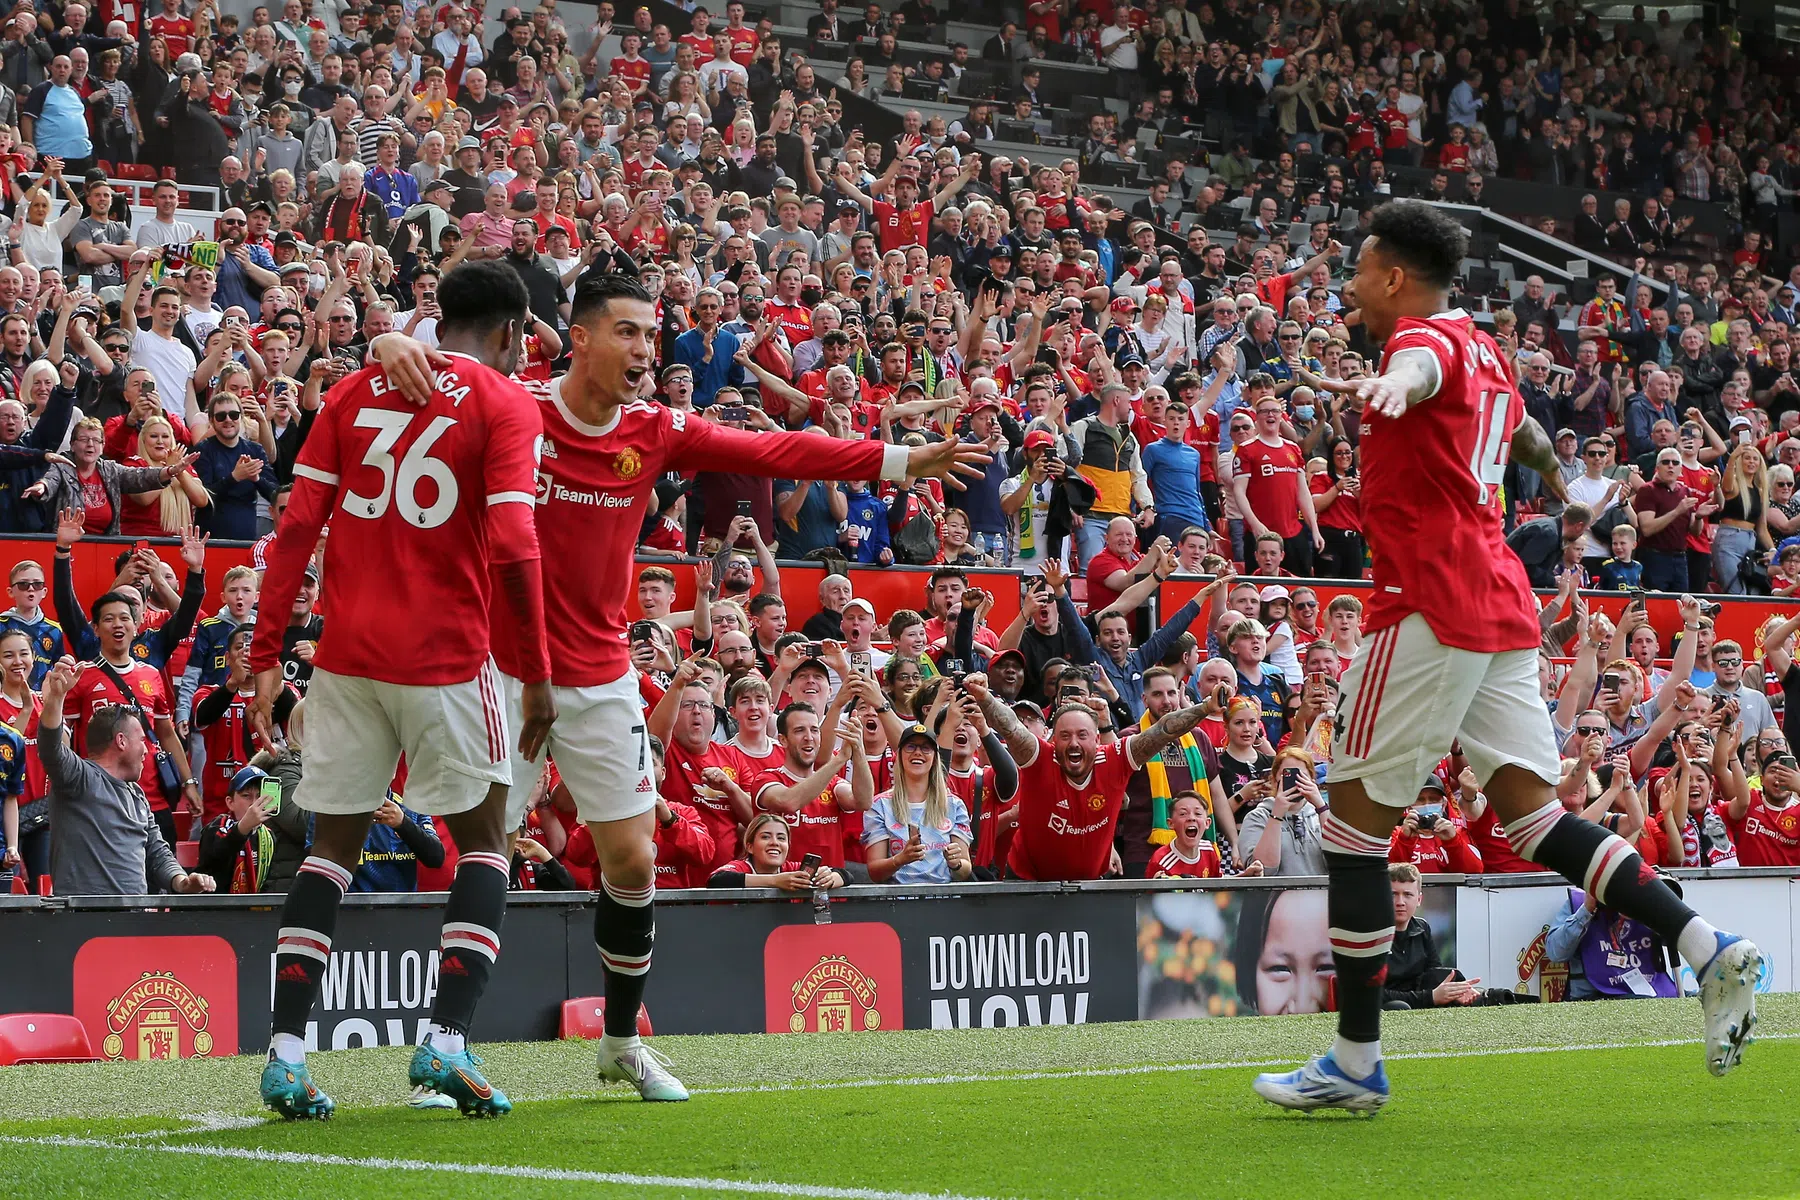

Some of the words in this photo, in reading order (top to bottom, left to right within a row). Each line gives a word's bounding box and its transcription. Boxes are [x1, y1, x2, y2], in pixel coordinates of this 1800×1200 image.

[780, 321, 810, 331] SHARP
[369, 369, 472, 408] ELNGA
[341, 407, 459, 529] 36
[553, 483, 635, 508] TeamViewer
[631, 724, 646, 771] 7
[1065, 815, 1109, 835] TeamViewer
[1758, 824, 1798, 845] TeamViewer
[364, 851, 416, 861] TeamViewe
[929, 930, 1090, 991] DOWNLOAD
[114, 981, 201, 1025] MANCHESTER
[798, 964, 870, 1005] MANCHESTER
